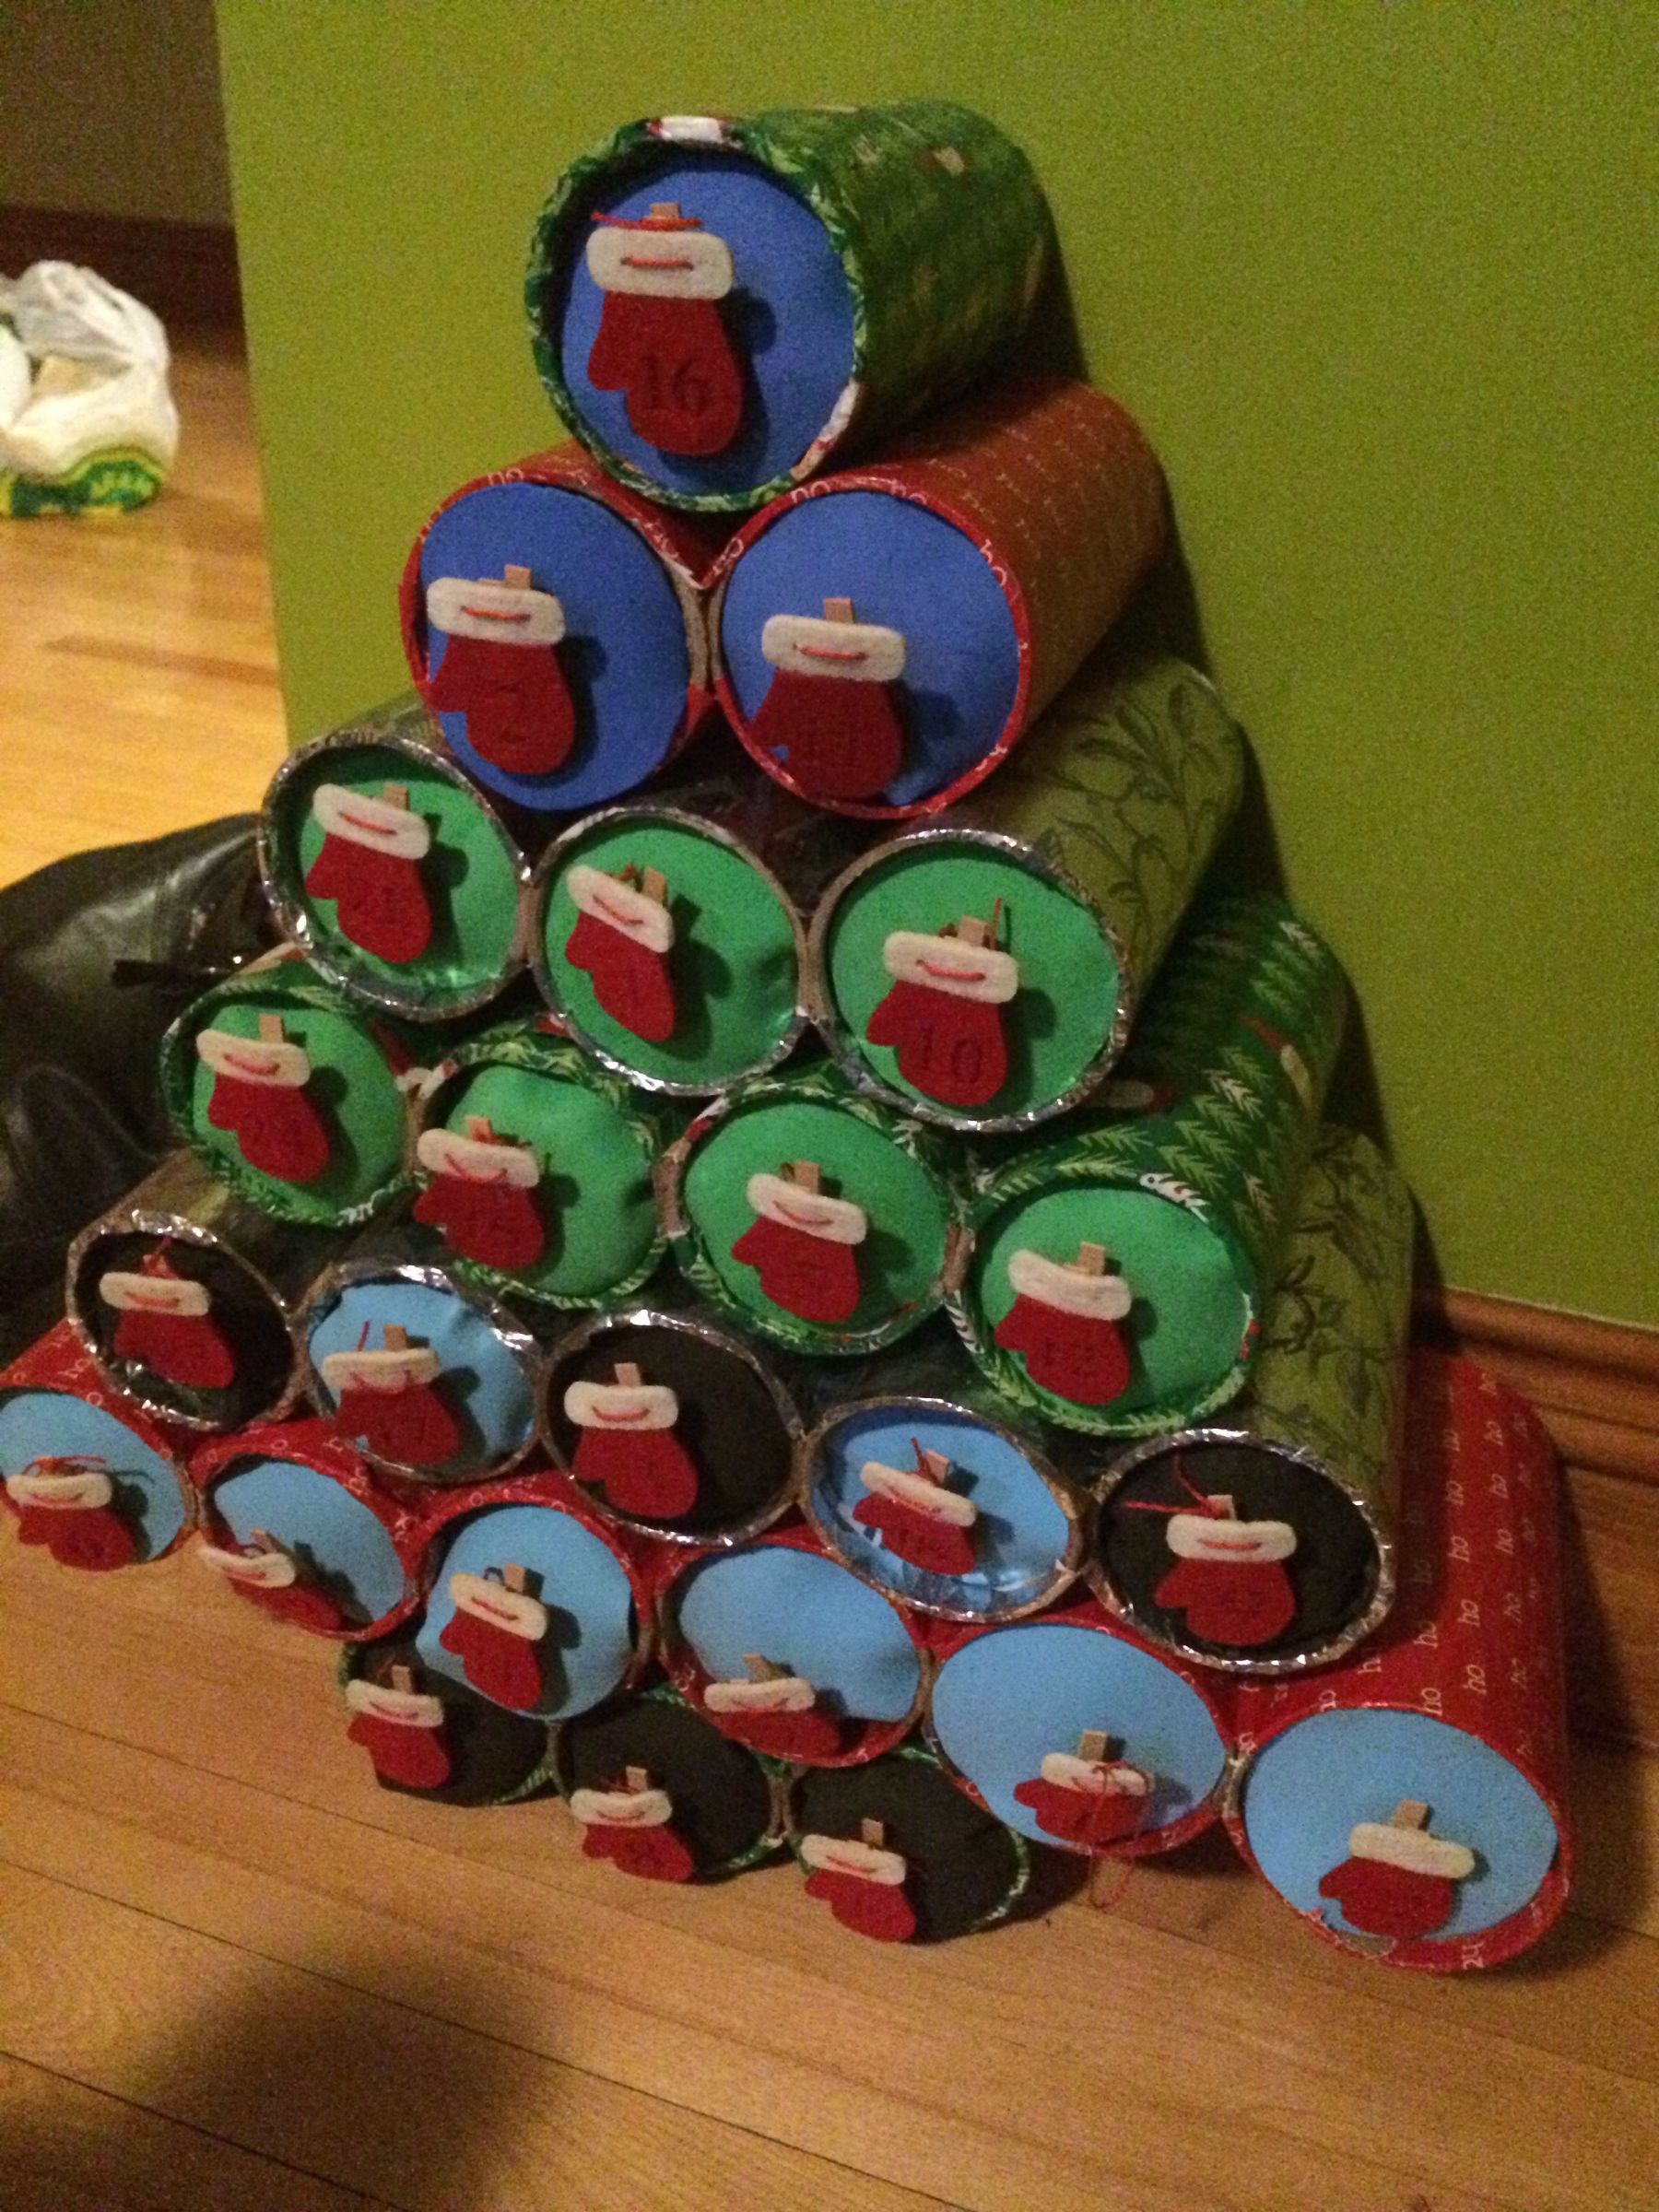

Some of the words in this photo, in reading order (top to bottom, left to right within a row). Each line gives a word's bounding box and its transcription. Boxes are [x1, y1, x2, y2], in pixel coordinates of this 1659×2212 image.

[640, 353, 713, 417] 16
[915, 1024, 985, 1085] 10
[1441, 1427, 1461, 1453] ho
[1483, 1419, 1504, 1447] ho
[1443, 1479, 1465, 1506] ho
[1488, 1472, 1510, 1500] ho
[1446, 1534, 1471, 1564] ho
[1493, 1527, 1514, 1557] ho
[1455, 1598, 1481, 1629] ho
[1502, 1592, 1524, 1626] ho
[1412, 1619, 1439, 1650] ho
[1461, 1663, 1488, 1697] ho
[1508, 1656, 1528, 1692] ho
